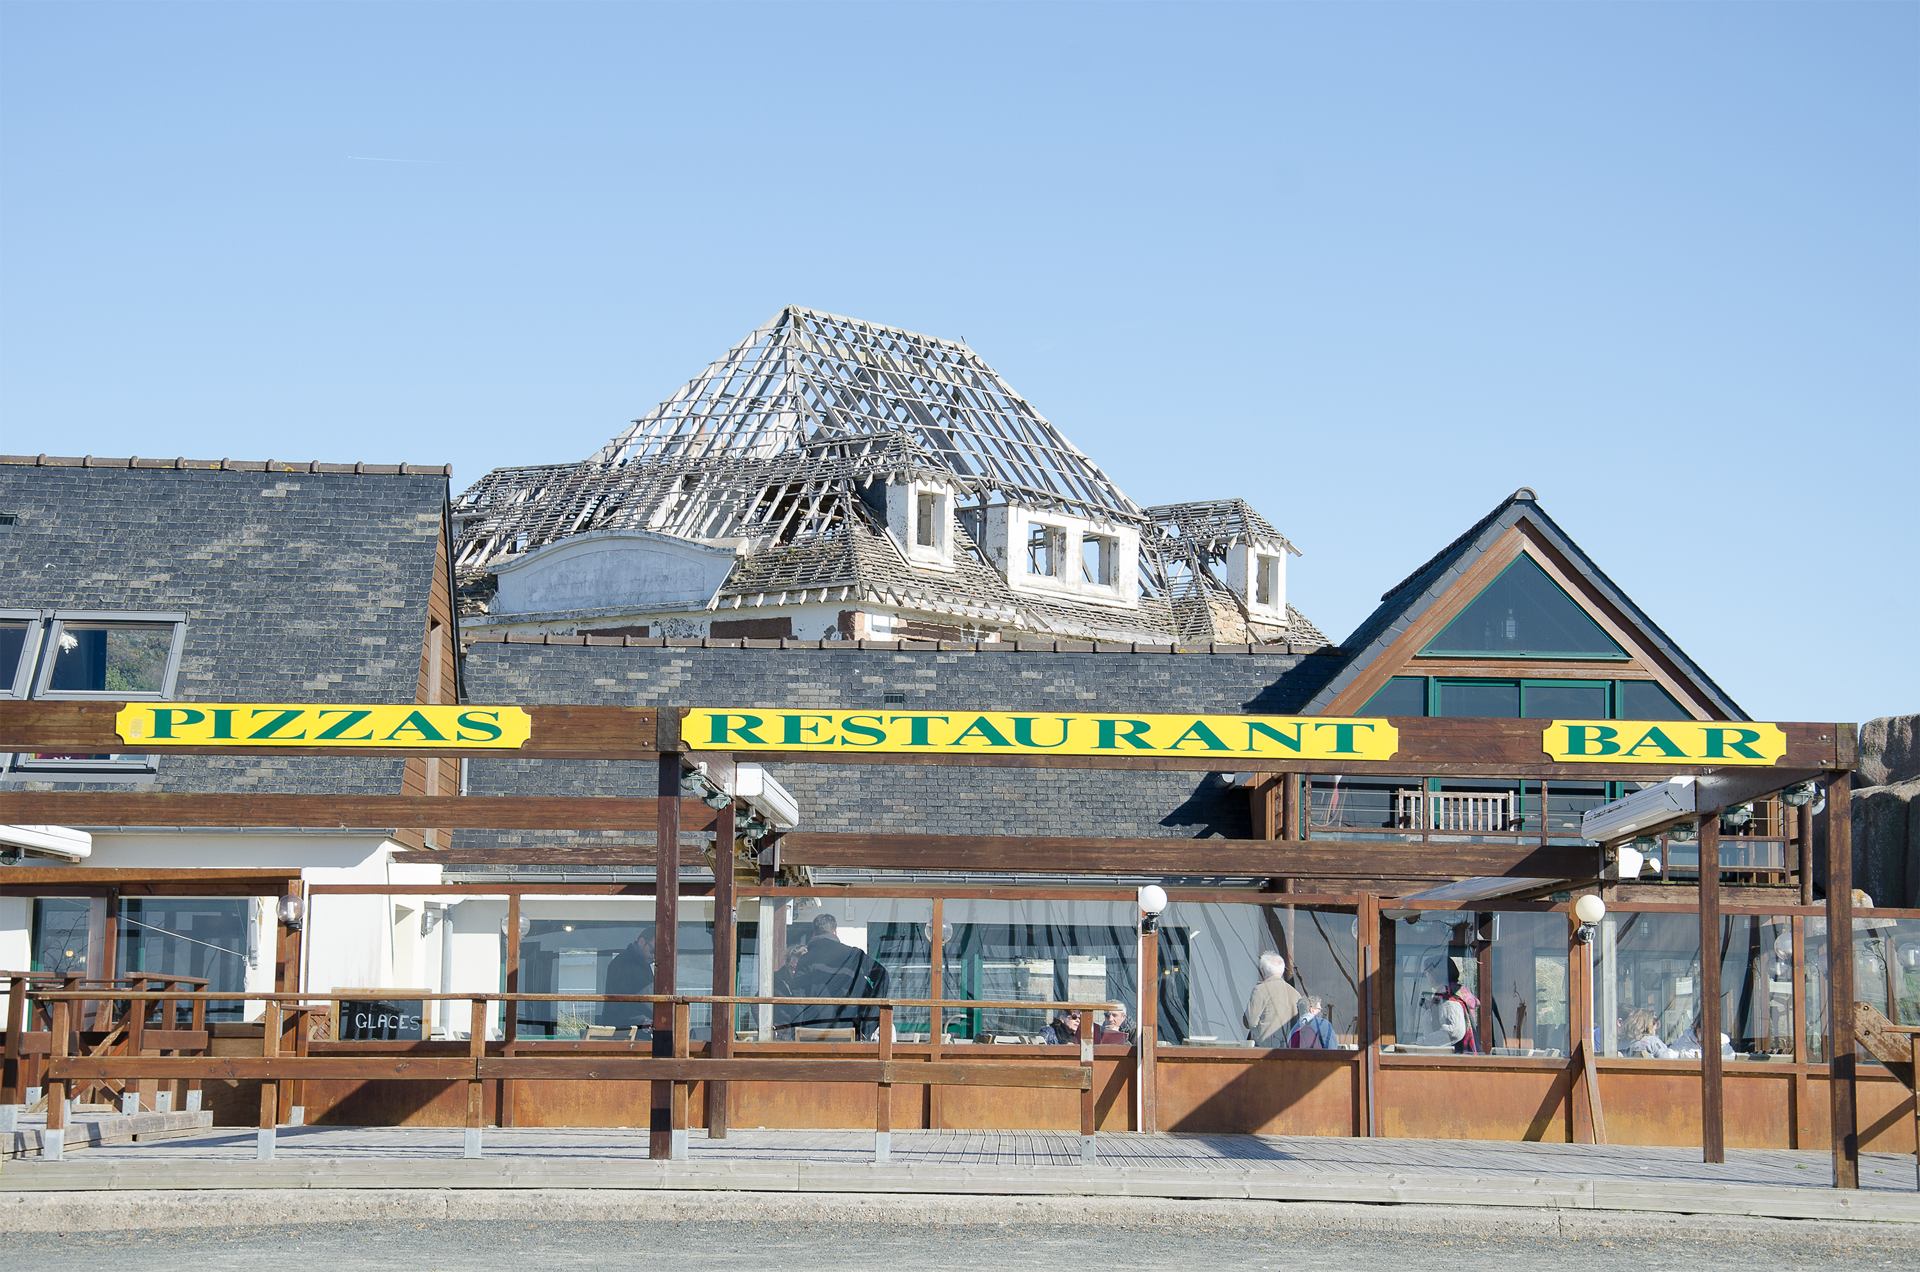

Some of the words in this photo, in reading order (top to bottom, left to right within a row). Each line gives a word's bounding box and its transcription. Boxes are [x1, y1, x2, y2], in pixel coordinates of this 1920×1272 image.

[146, 708, 503, 742] PIZZAS
[705, 714, 1375, 754] RESTAURANT
[1562, 725, 1766, 759] BAR
[355, 1012, 421, 1031] GLACES
